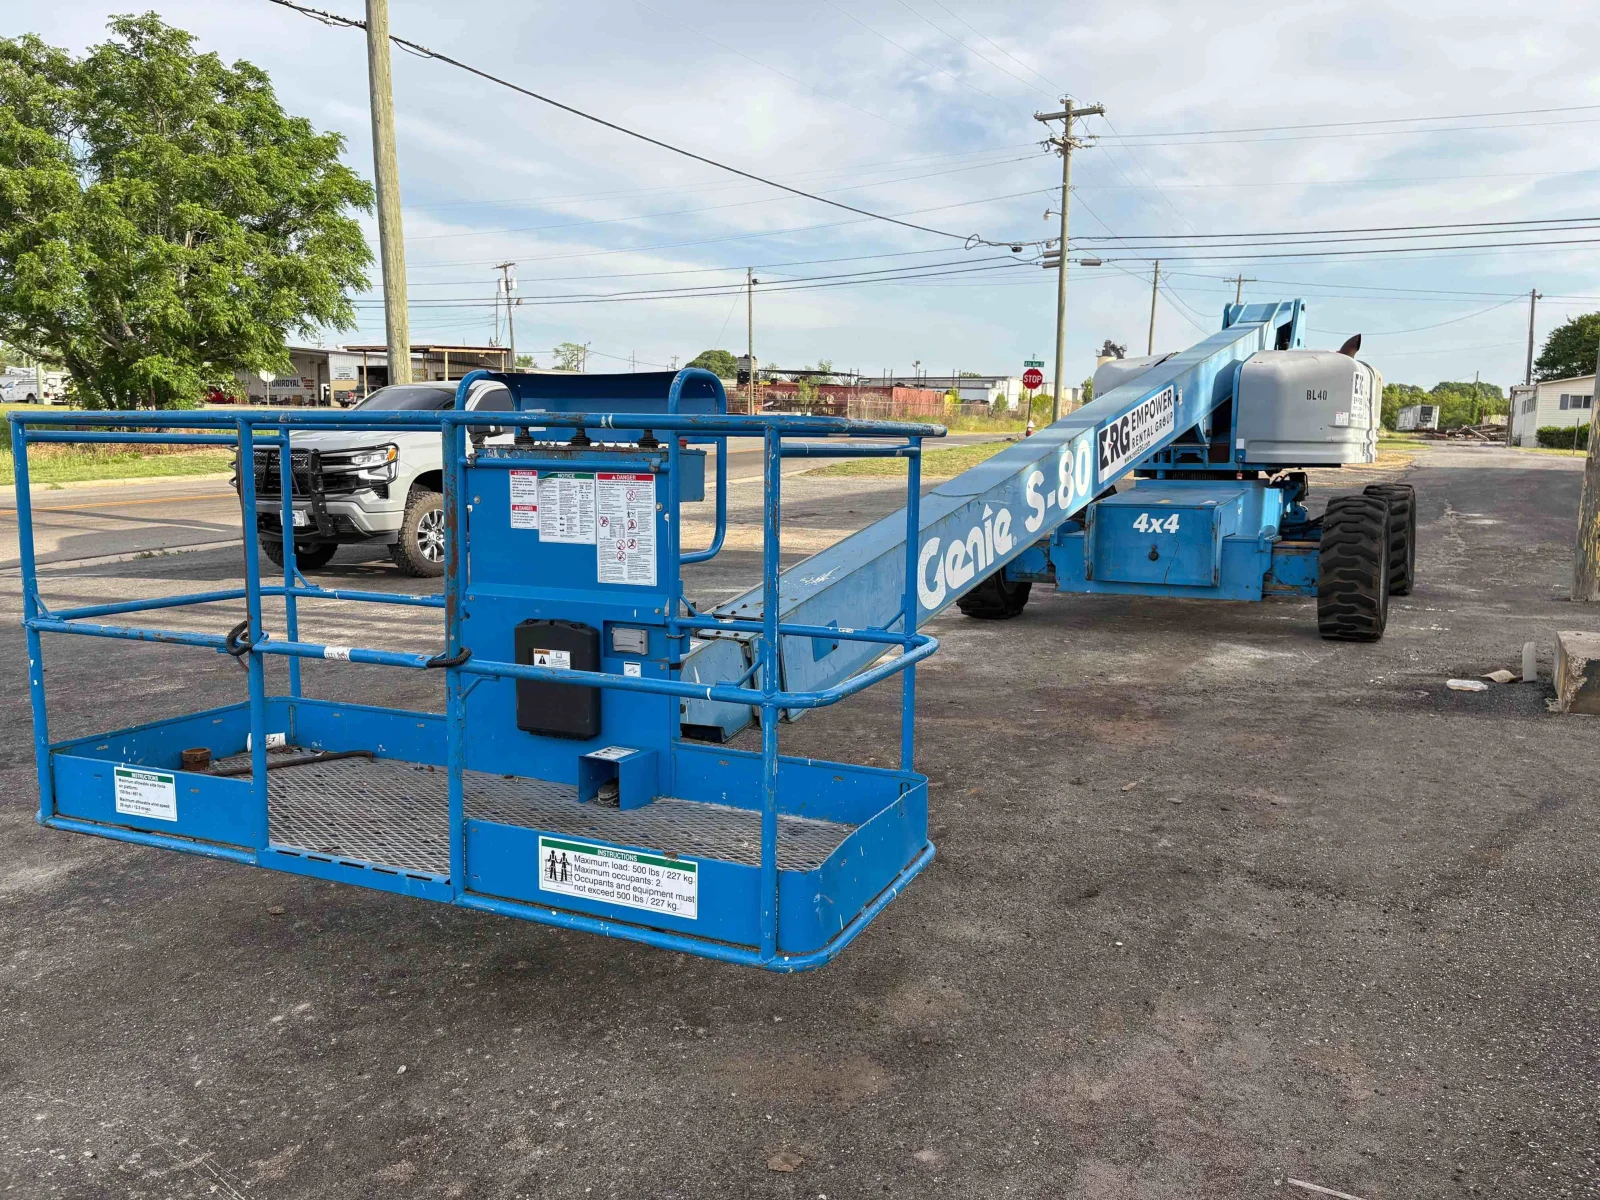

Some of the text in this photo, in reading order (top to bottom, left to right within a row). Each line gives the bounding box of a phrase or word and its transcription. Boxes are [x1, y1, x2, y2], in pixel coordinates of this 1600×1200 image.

[272, 379, 300, 387] UNIROYAL
[1024, 375, 1041, 383] STOP
[1306, 389, 1328, 401] BL40
[1131, 389, 1173, 432] EMPOWER
[1132, 411, 1173, 449] RENTAL GROUP
[918, 438, 1090, 610] Genie S-80
[1132, 513, 1180, 534] 4x4
[131, 773, 158, 781] INSTRUCTIONS
[597, 849, 638, 862] INSTRUCTIONS
[574, 854, 610, 868] Maximum
[611, 861, 630, 871] load:
[632, 865, 647, 874] 500
[648, 867, 660, 877] lbs
[666, 871, 681, 880] 227
[683, 874, 694, 884] kg.
[574, 864, 610, 877] Maximum
[612, 872, 654, 886] occupants:
[574, 874, 695, 903] Occupants and equipment must
[574, 883, 586, 892] not
[588, 887, 614, 897] exceed
[616, 891, 631, 900] 500
[632, 894, 644, 904] lbs
[650, 898, 665, 907] 227
[667, 901, 679, 911] kg.
